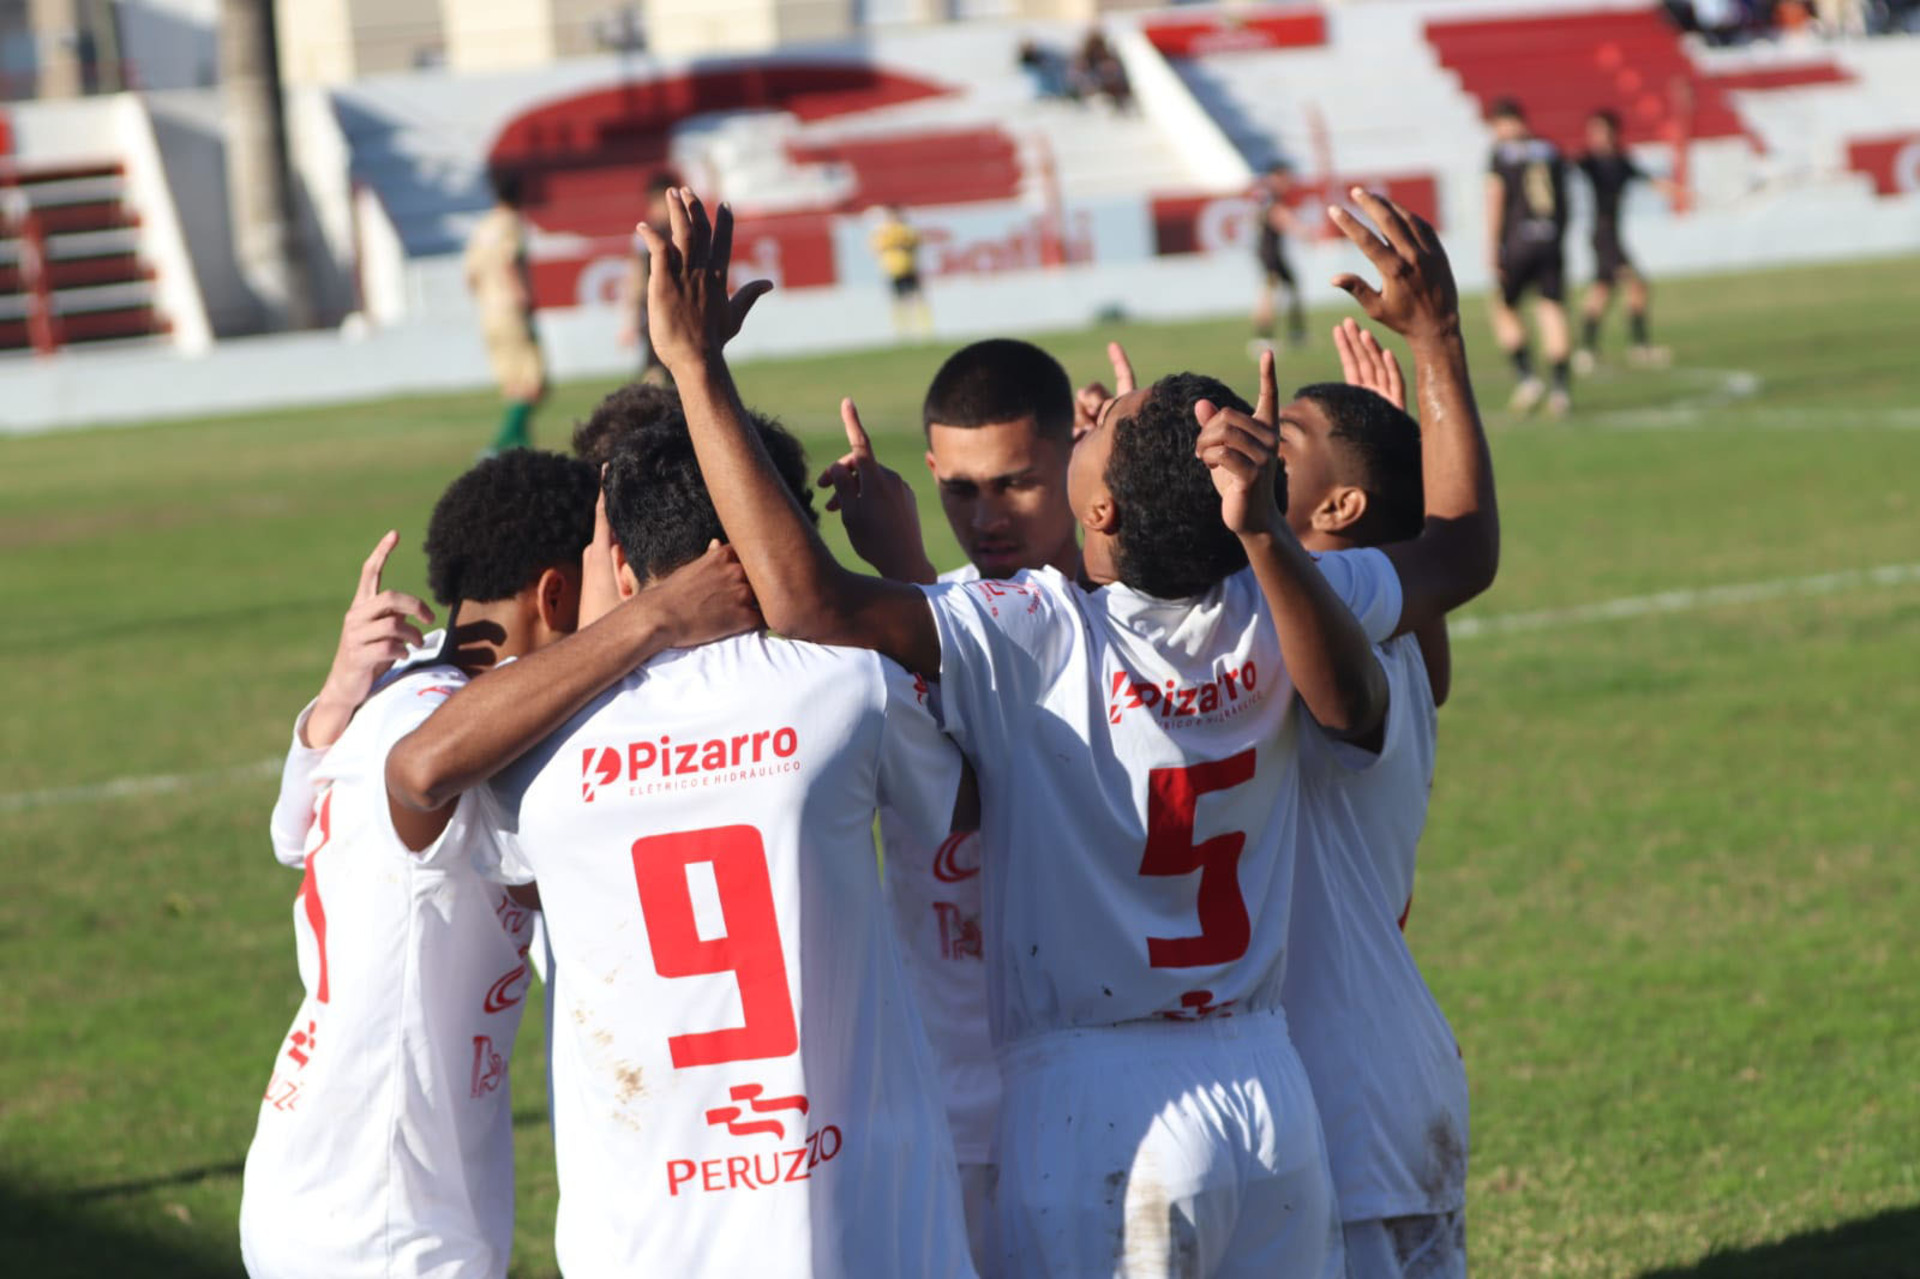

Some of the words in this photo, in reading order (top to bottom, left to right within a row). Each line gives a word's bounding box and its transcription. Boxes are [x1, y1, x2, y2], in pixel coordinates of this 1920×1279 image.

[628, 726, 798, 782] Pizarro
[1138, 748, 1257, 968] 5
[631, 823, 799, 1069] 9
[666, 1124, 843, 1196] PERUZZO
